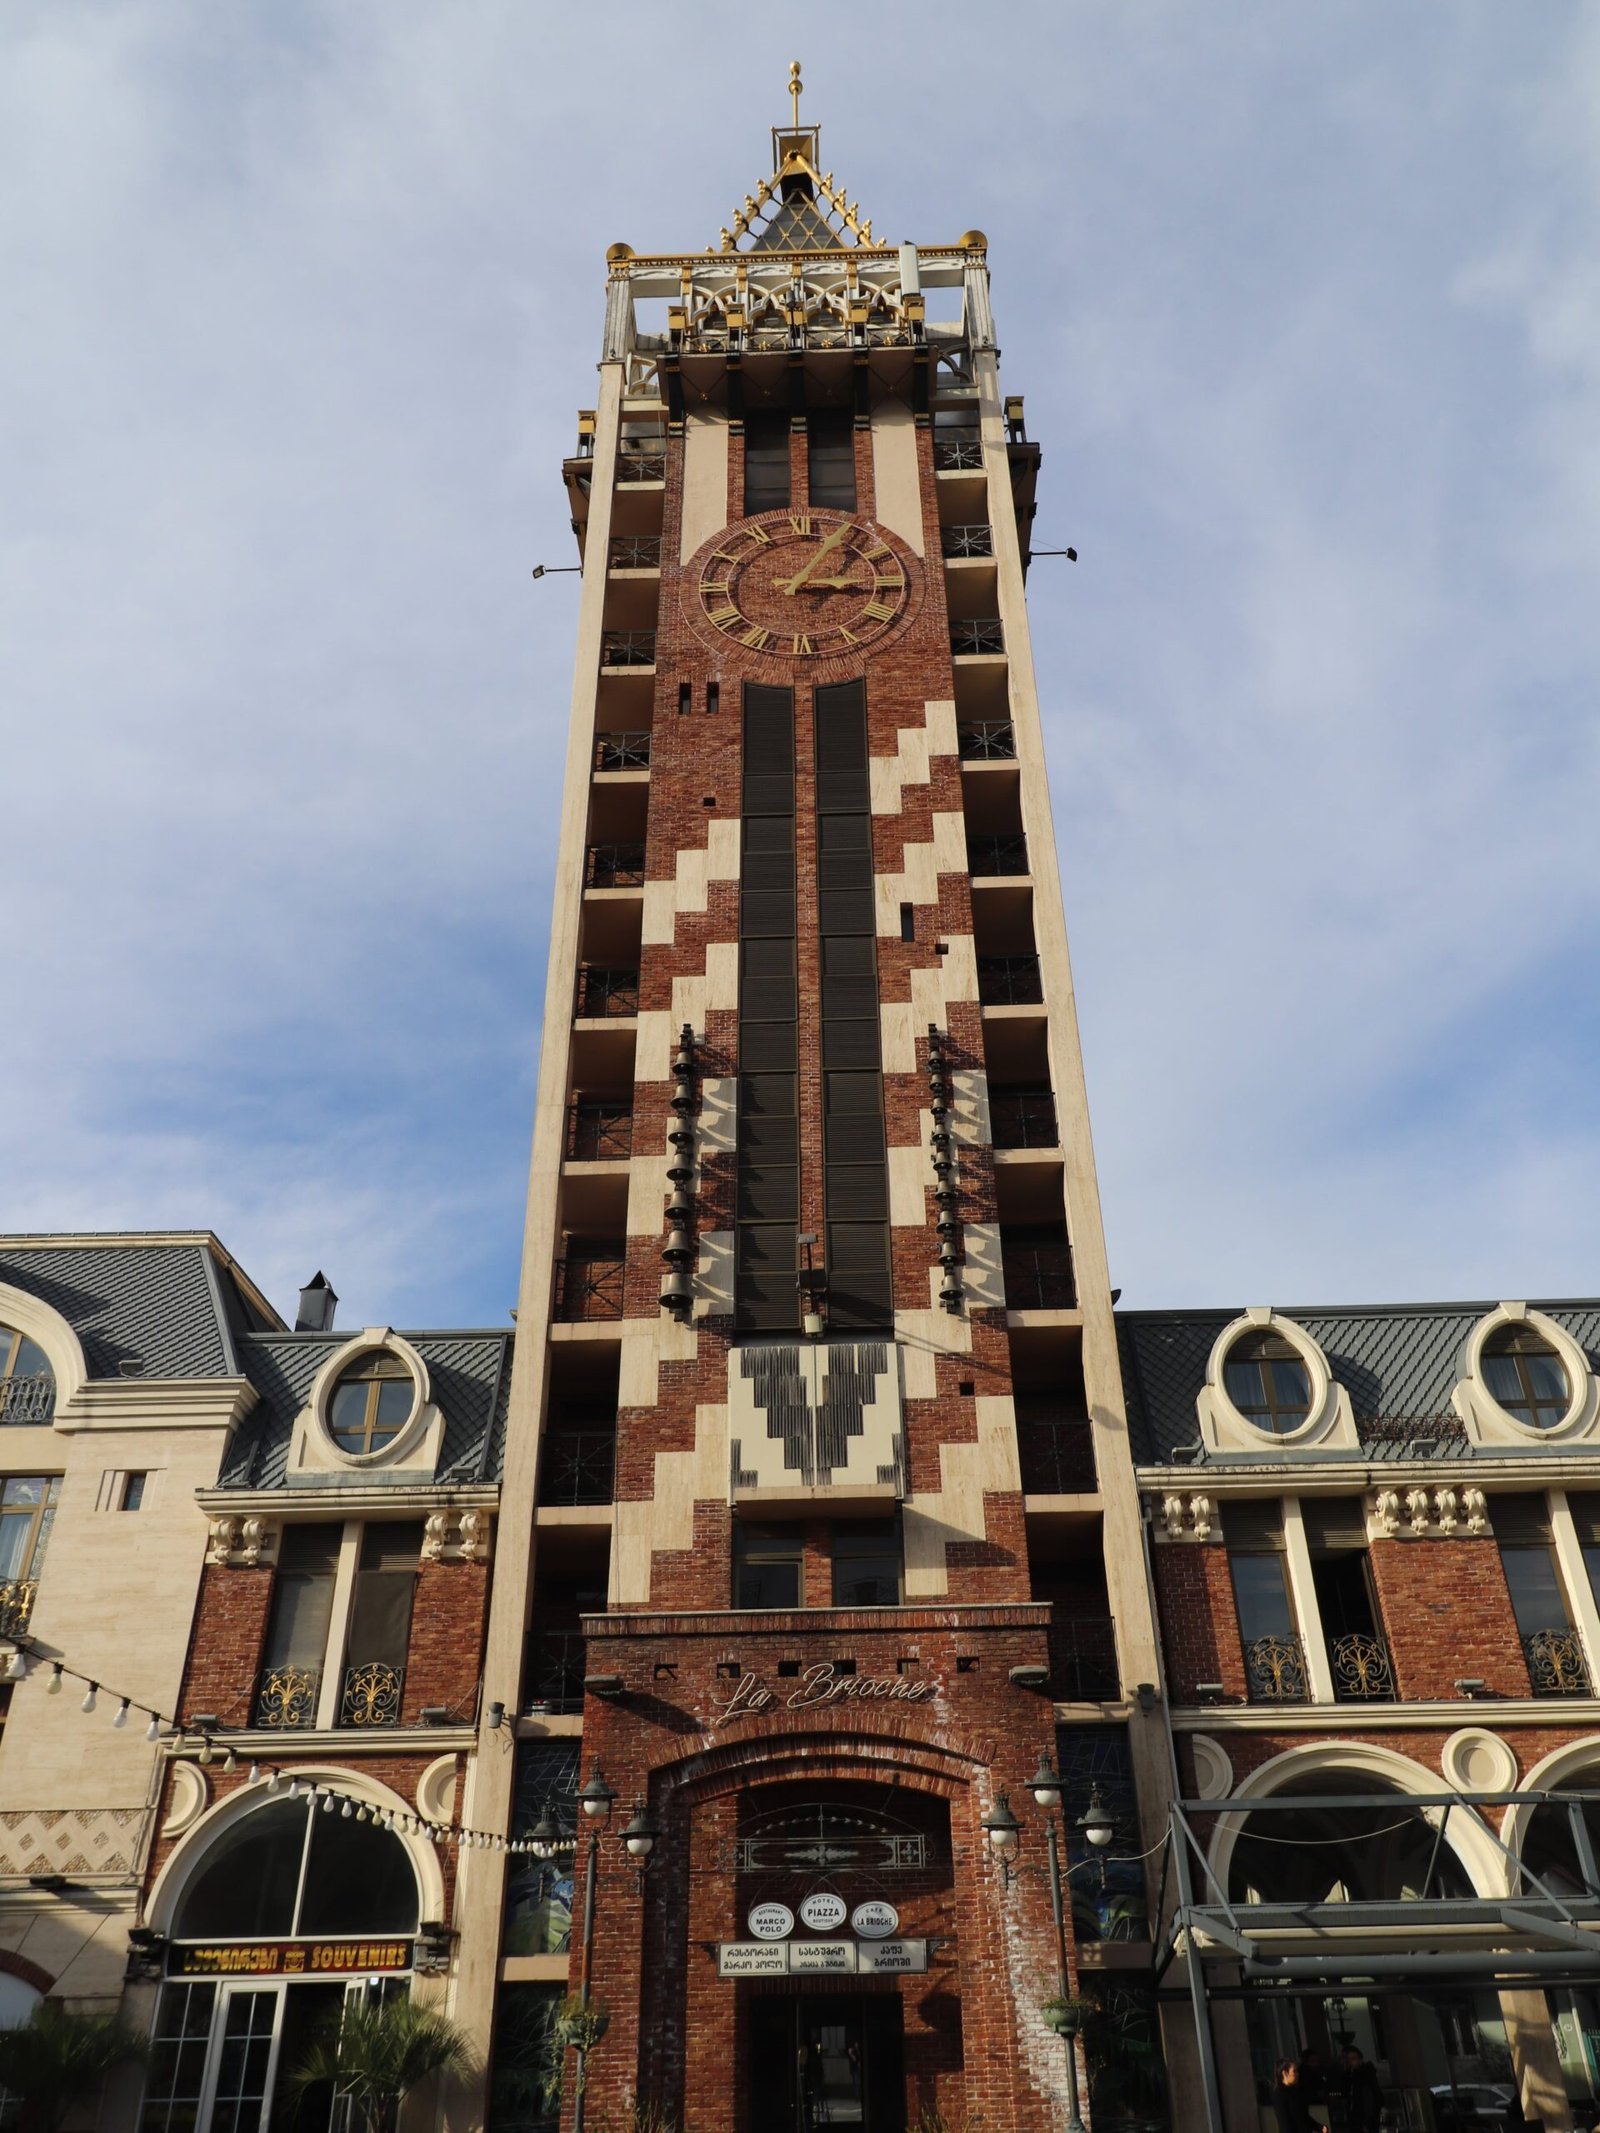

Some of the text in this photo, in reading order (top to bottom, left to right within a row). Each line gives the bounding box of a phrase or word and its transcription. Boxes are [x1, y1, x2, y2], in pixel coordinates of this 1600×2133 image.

[789, 516, 811, 535] XII
[743, 523, 770, 544] XI
[863, 544, 890, 560] II
[699, 580, 728, 593] IX
[875, 575, 904, 587] III
[713, 1663, 926, 1727] La Brioche
[807, 1908, 840, 1917] PIAZZA
[857, 1917, 893, 1926] LA BRIOCHE
[760, 1925, 782, 1933] POLO
[311, 1943, 407, 1968] SOUVENIRS
[727, 1947, 779, 1957] რესტორანი
[798, 1947, 846, 1957] სასტუმრო
[880, 1945, 903, 1955] კაფე
[874, 1957, 911, 1967] ბრიოში
